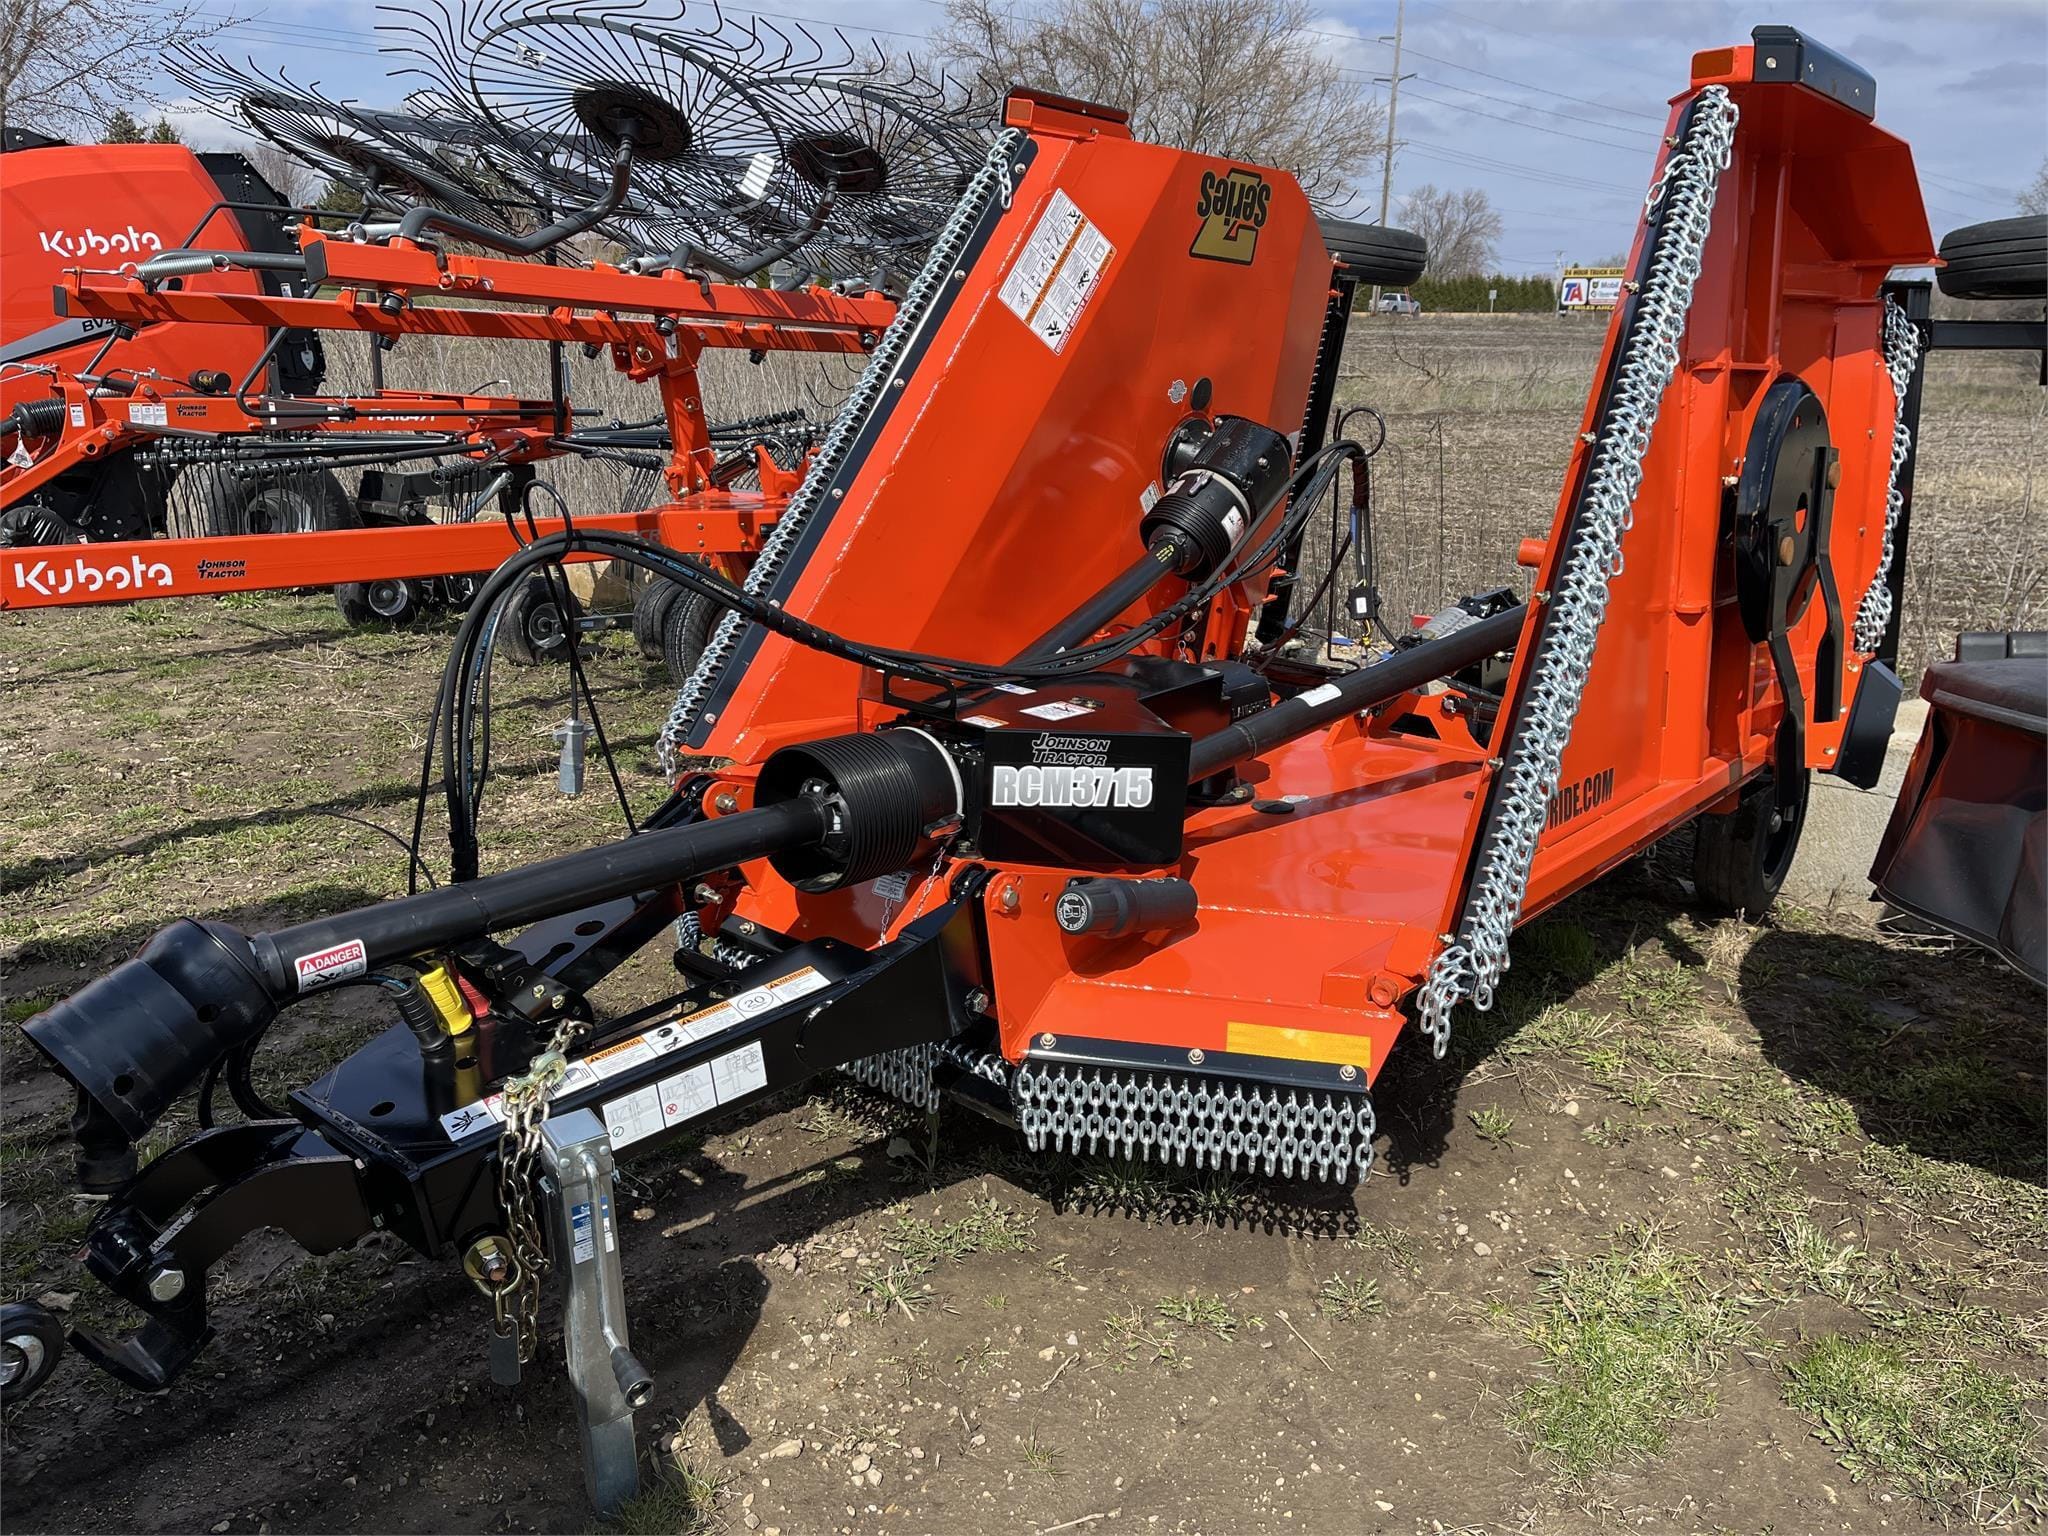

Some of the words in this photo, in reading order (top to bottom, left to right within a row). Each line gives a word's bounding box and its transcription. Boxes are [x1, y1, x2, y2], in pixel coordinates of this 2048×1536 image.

[1197, 171, 1271, 228] series
[39, 225, 162, 258] Kubota
[1564, 283, 1583, 301] TA
[14, 555, 173, 595] Kubota
[197, 559, 246, 569] JOHNSON
[198, 569, 246, 579] TRACTOR
[1032, 733, 1111, 751] JOHNSON
[1032, 750, 1107, 766] TRACTOR
[992, 765, 1153, 807] RCM3715
[1541, 768, 1615, 834] RIDE.COM
[315, 947, 361, 970] DANGER
[777, 965, 814, 987] WARNING
[690, 1001, 731, 1024] WARNING
[744, 995, 766, 1011] 20
[599, 1036, 642, 1063] WARNING
